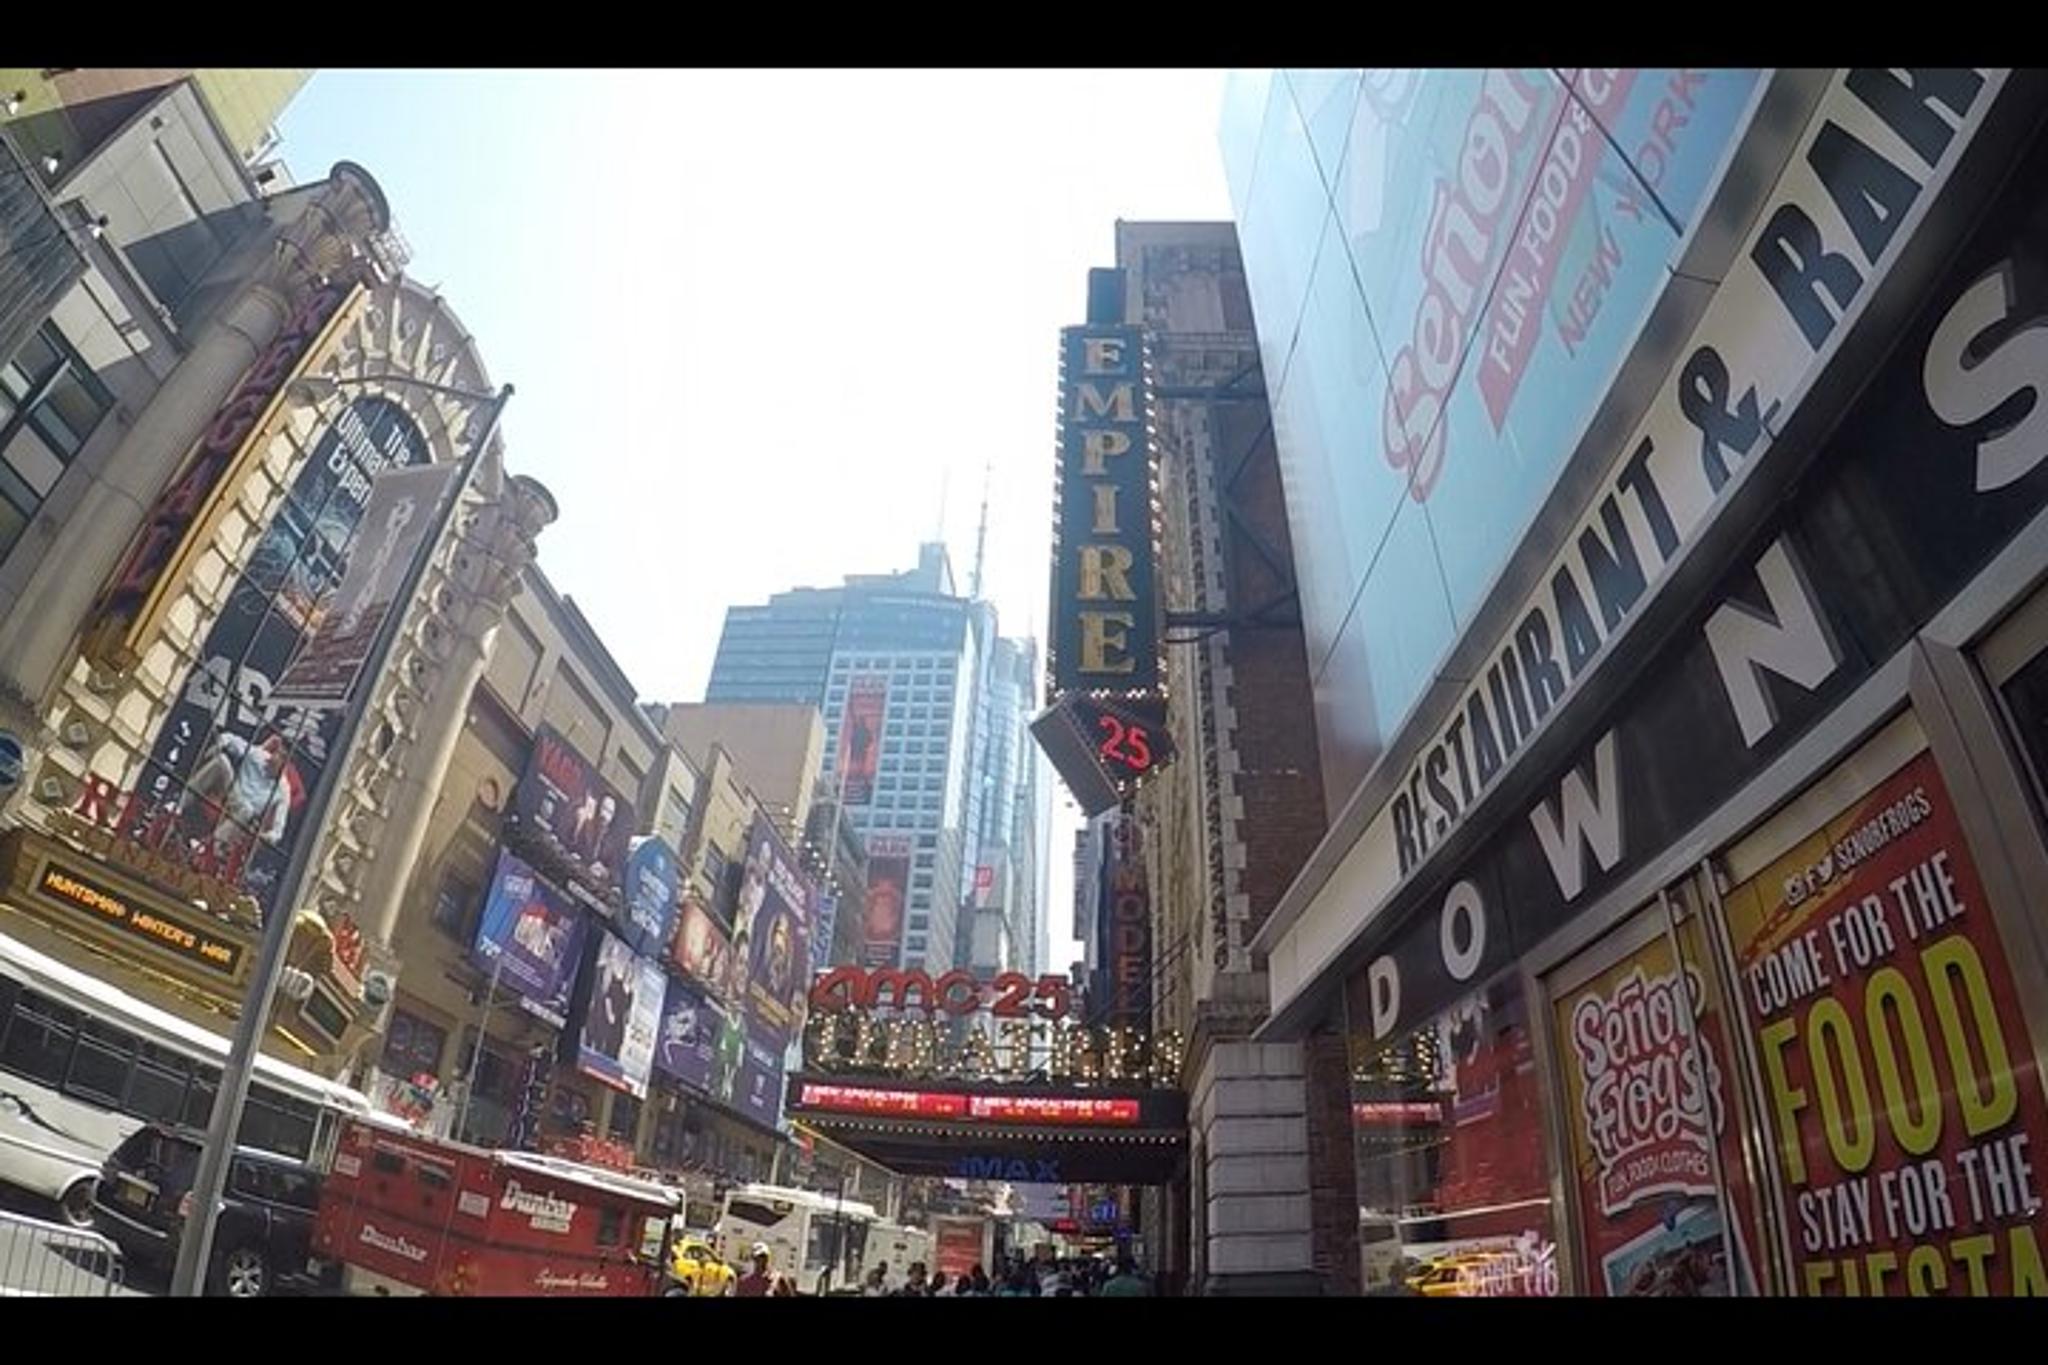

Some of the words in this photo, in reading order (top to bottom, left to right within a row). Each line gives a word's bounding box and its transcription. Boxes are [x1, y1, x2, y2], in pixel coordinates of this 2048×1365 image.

[1557, 226, 1623, 358] NEW
[1611, 70, 1708, 228] YORK
[1072, 337, 1138, 675] EMPIRE
[1391, 434, 1681, 875] RESTAURANT
[1679, 345, 1766, 494] &
[1099, 713, 1151, 769] 25
[1750, 930, 1826, 1016] COME
[1833, 894, 1895, 976] FOR
[1889, 850, 1966, 939] THE
[989, 972, 1072, 1018] 25
[1577, 974, 1697, 1077] Señor
[1760, 934, 2019, 1185] FOOD
[359, 1224, 428, 1261] Dunbar
[501, 1180, 578, 1220] Dunbar
[1799, 1180, 1874, 1252] STAY
[1882, 1159, 1956, 1239] FOR
[1956, 1134, 2042, 1225] THE
